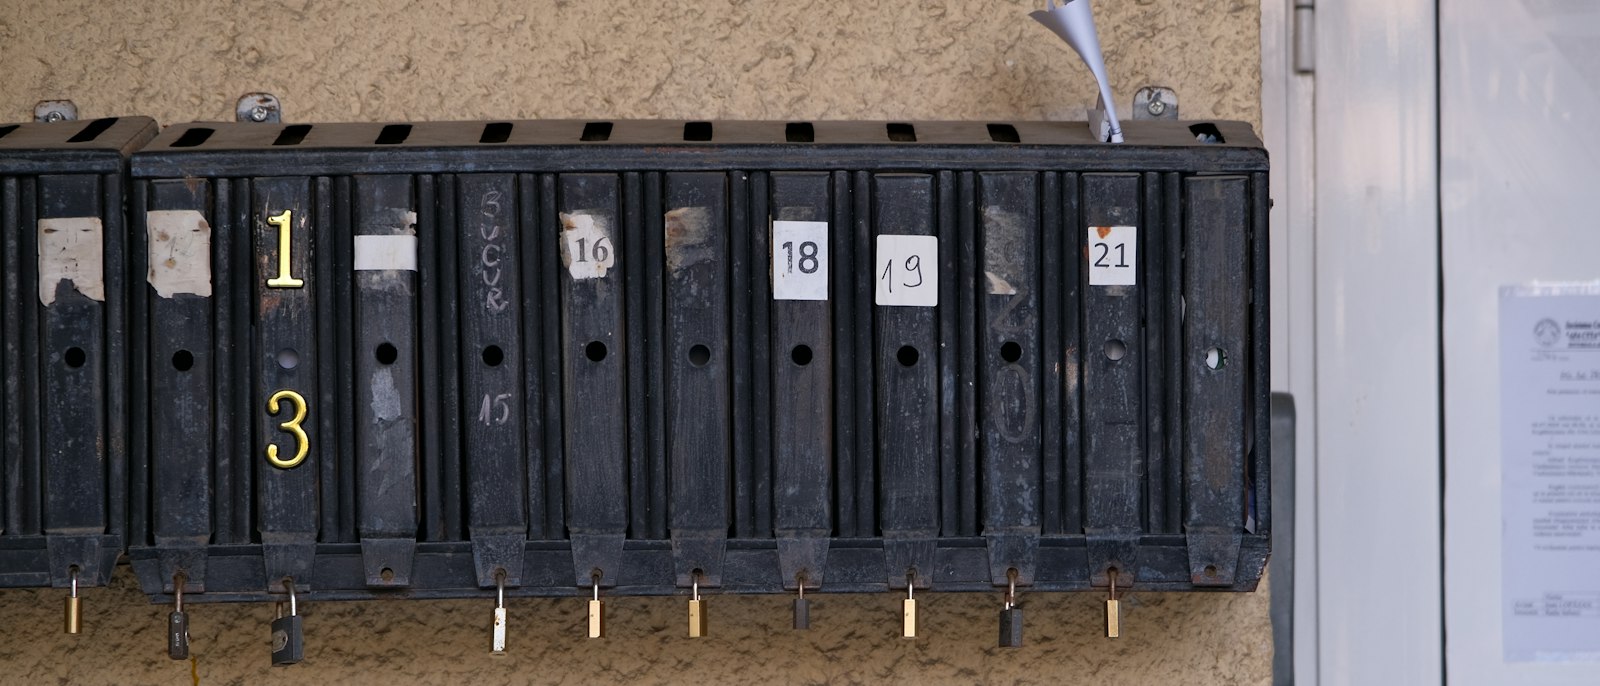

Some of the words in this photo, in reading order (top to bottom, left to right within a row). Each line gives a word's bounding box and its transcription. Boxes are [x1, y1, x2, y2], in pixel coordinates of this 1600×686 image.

[575, 236, 609, 263] 16
[782, 241, 819, 274] 18
[1093, 242, 1130, 269] 21
[881, 254, 923, 294] 19
[478, 393, 512, 426] 15
